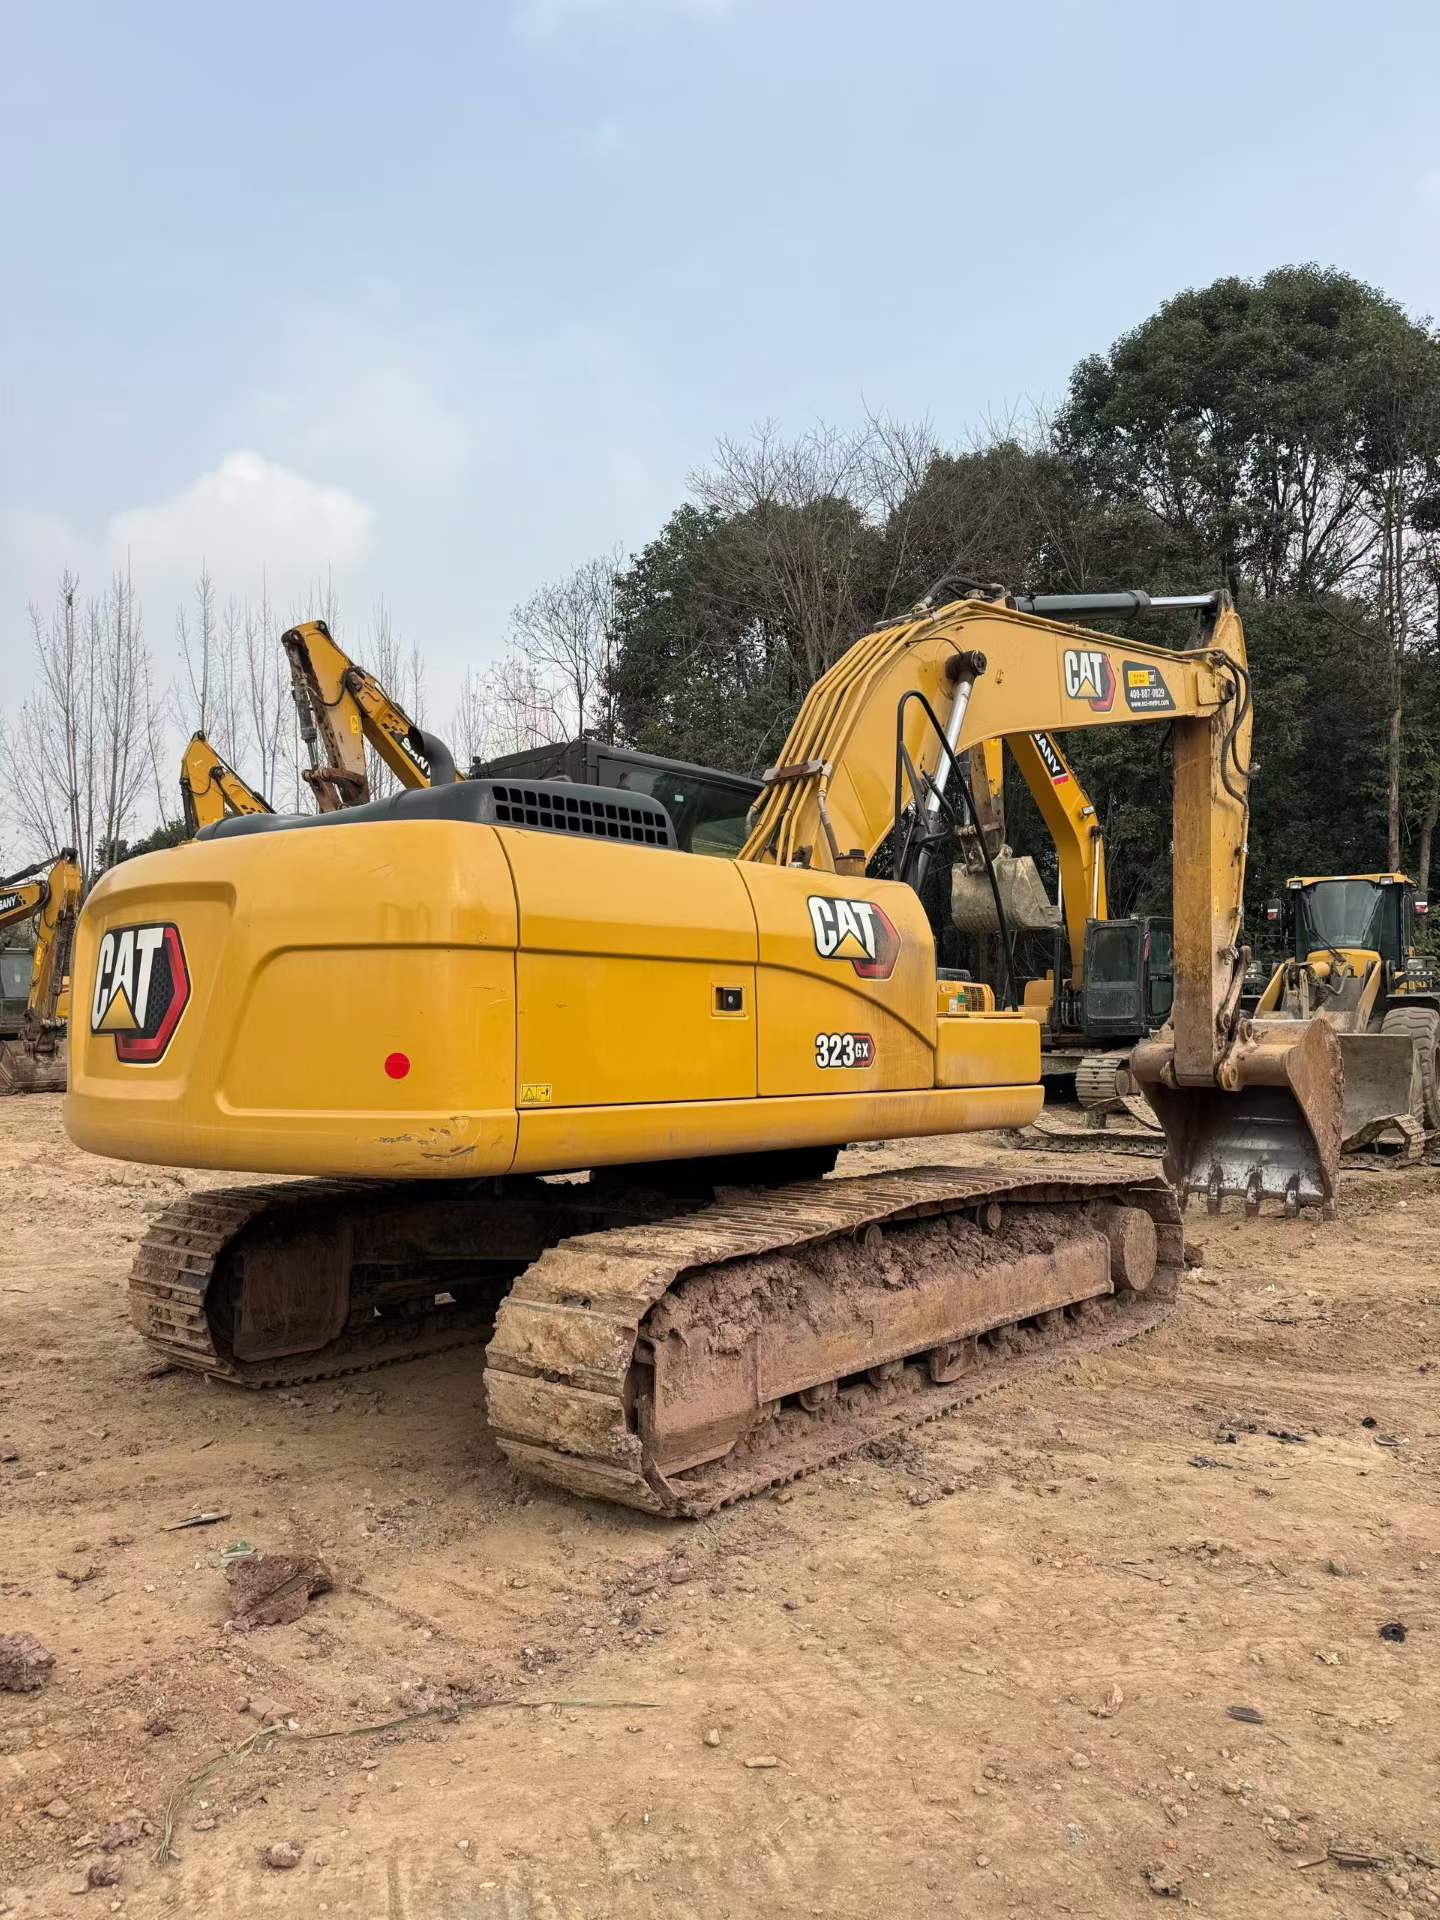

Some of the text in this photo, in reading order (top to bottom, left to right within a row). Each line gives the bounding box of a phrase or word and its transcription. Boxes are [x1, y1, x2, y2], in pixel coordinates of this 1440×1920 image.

[1064, 650, 1103, 698] CAT
[808, 896, 876, 959] CAT
[91, 927, 164, 1030] CAT
